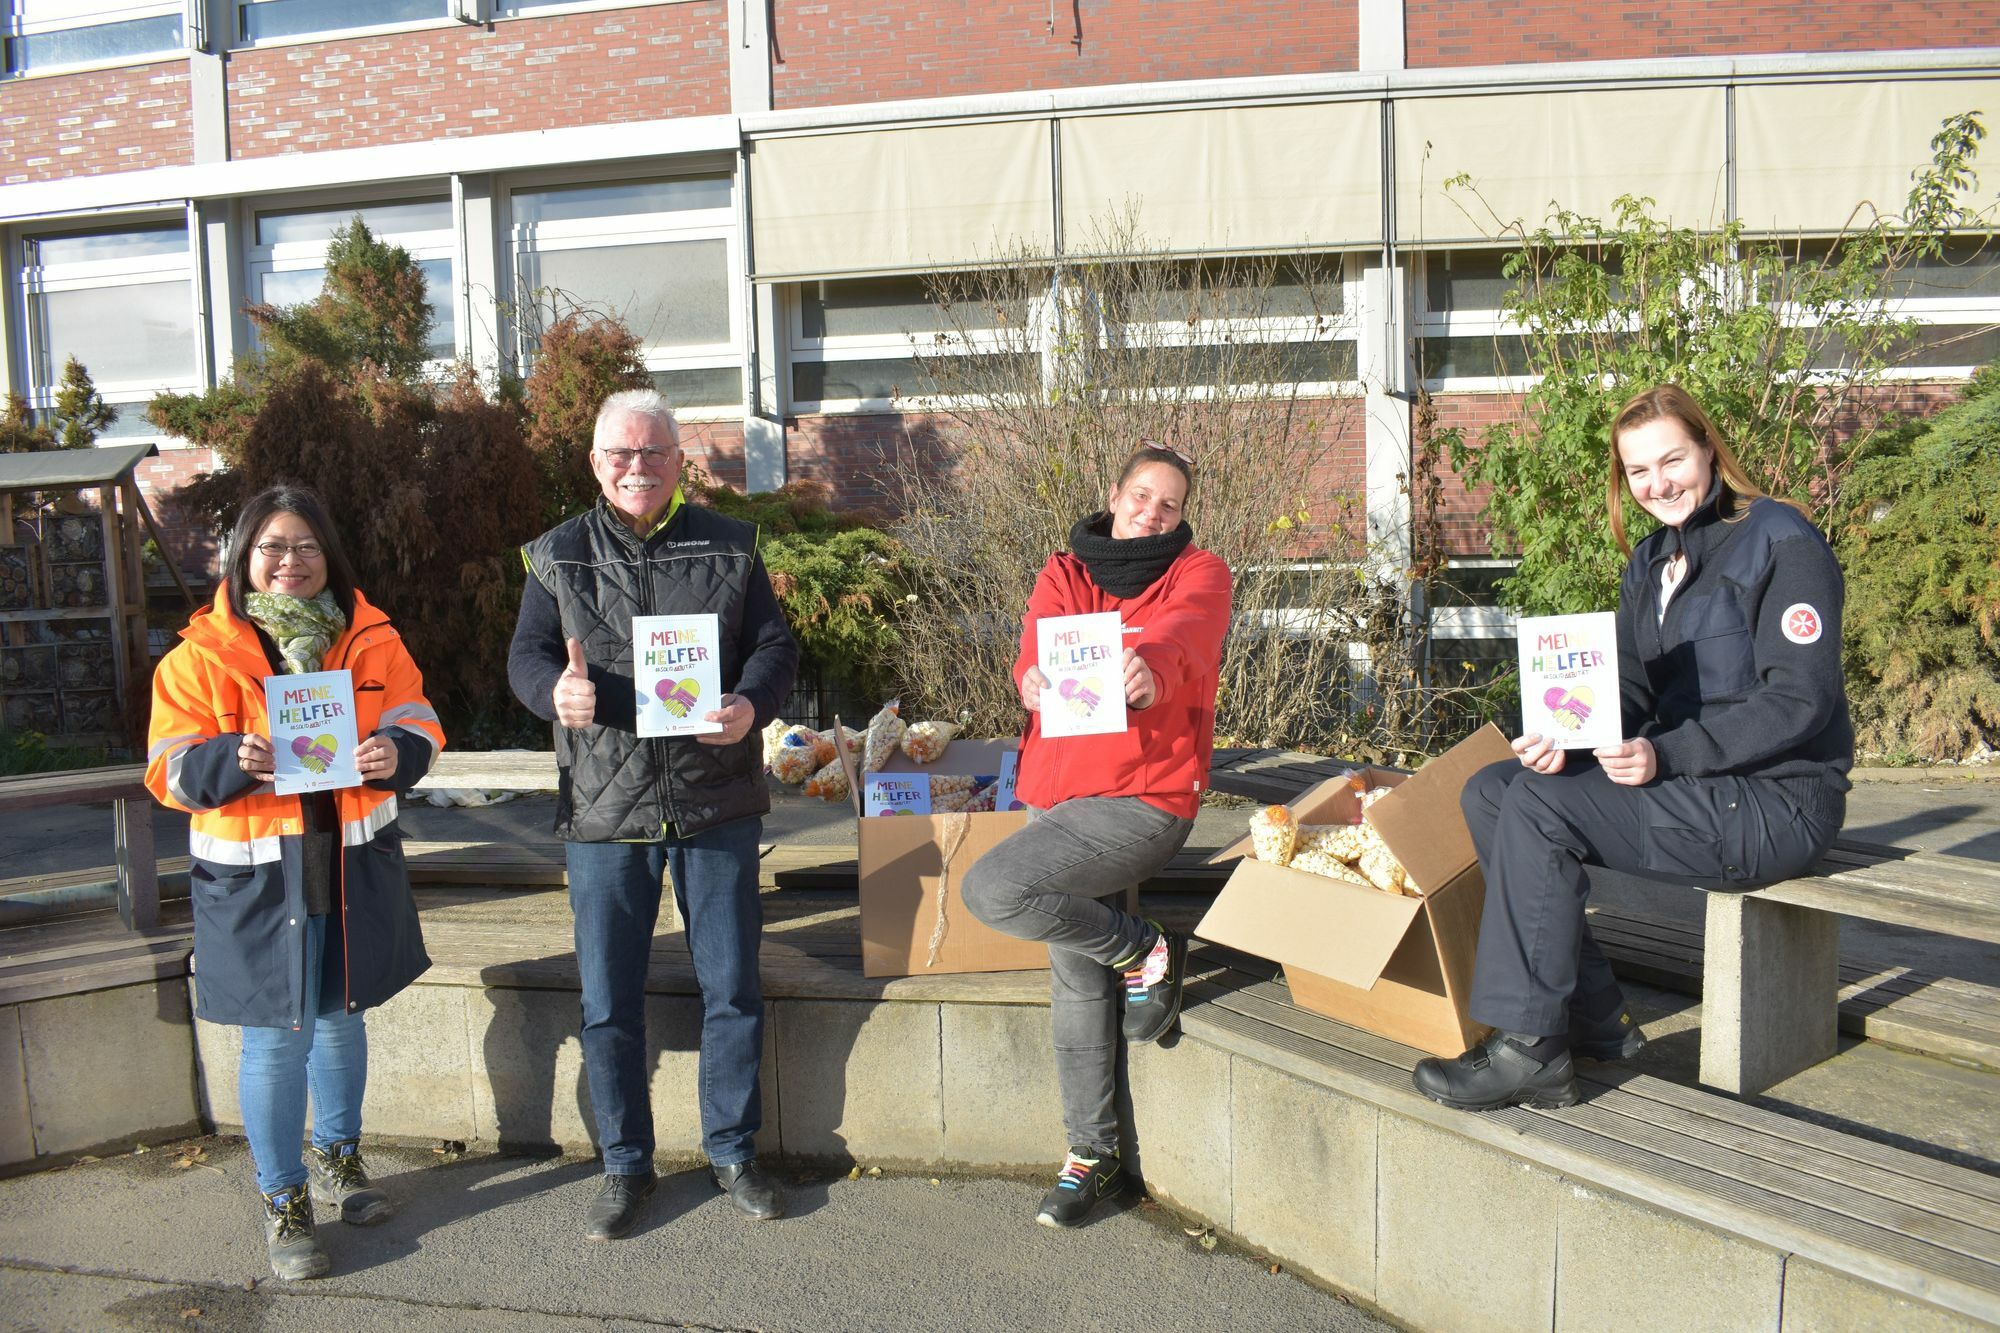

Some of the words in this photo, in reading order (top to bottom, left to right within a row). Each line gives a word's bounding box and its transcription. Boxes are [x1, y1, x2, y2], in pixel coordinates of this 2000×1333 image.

[650, 629, 700, 646] MEINE
[645, 646, 710, 666] HELFER
[1048, 645, 1112, 666] HELFER
[1531, 650, 1605, 673] HELFER
[284, 684, 335, 706] MEINE
[279, 702, 345, 725] HELFER
[877, 781, 913, 791] MEINE
[872, 791, 922, 802] HELFER
